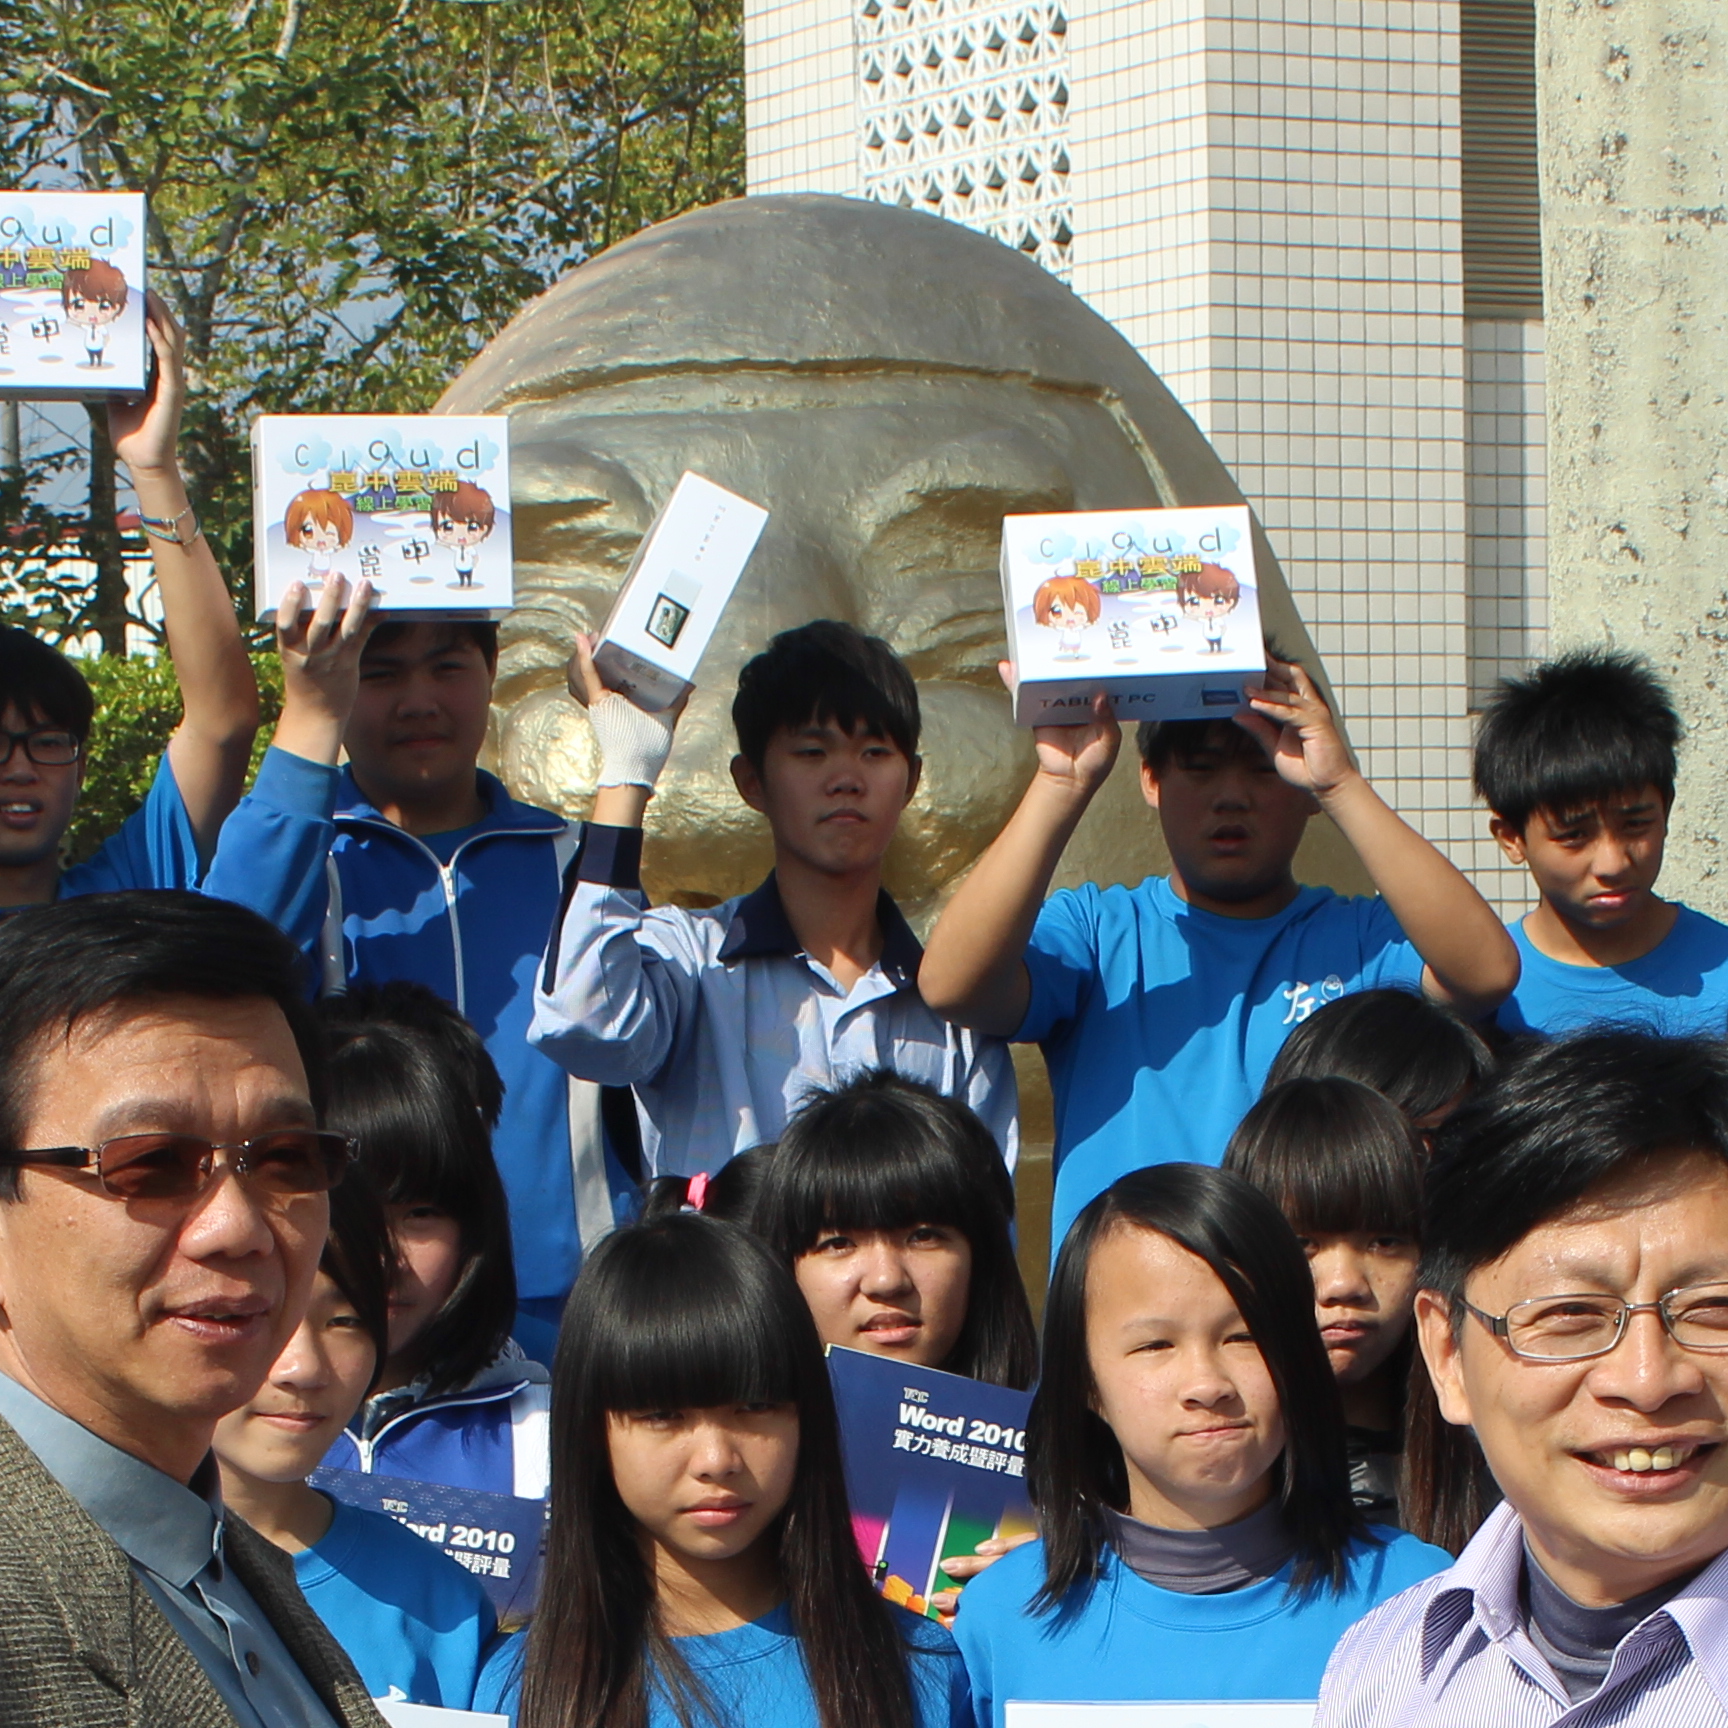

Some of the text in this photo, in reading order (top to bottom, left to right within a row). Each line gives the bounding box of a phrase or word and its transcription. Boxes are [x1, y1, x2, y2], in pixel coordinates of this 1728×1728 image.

[1040, 694, 1156, 709] TABLT PC
[899, 1402, 1026, 1451] Word 2010
[450, 1525, 515, 1553] 2010
